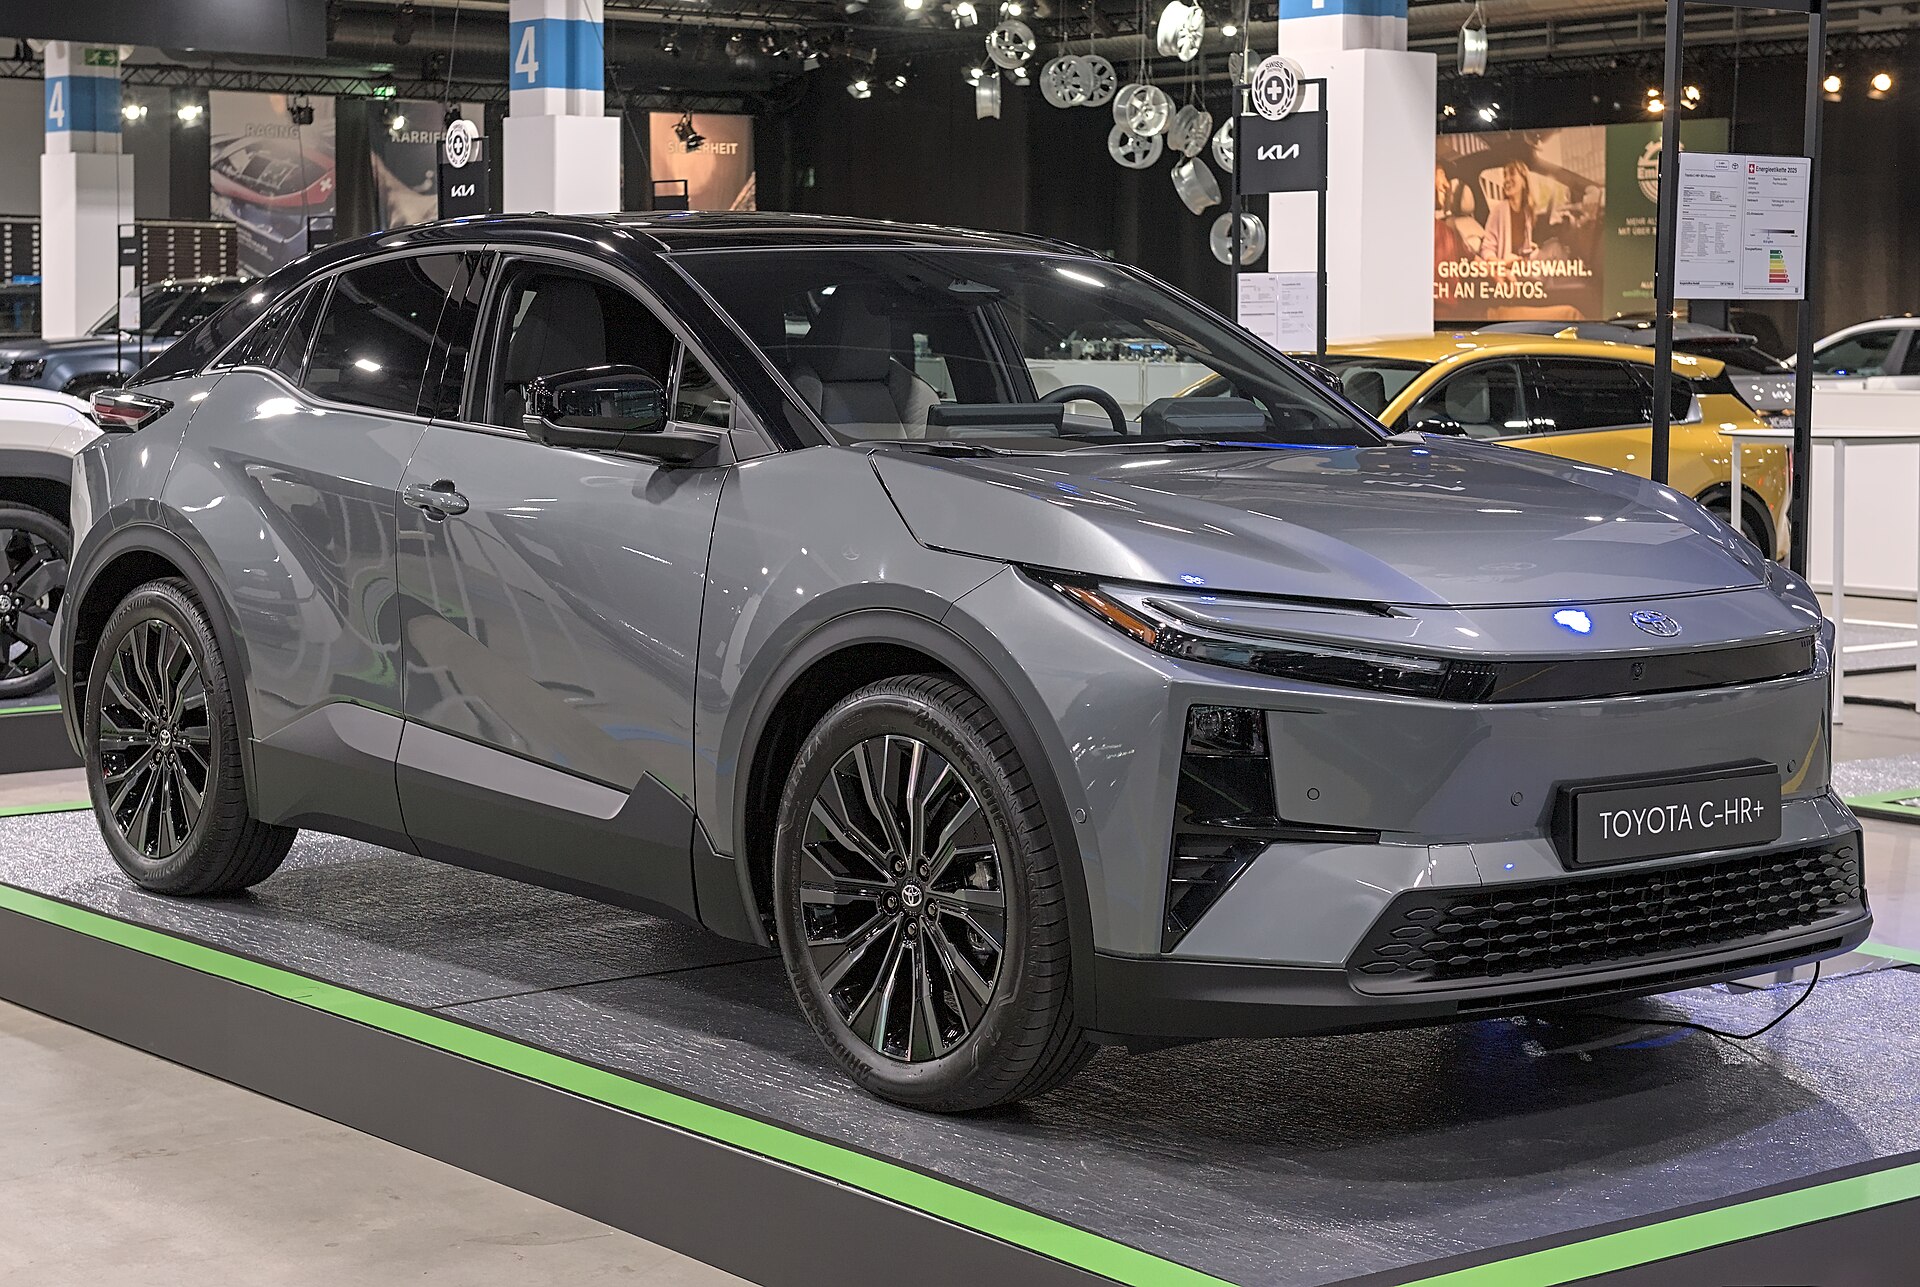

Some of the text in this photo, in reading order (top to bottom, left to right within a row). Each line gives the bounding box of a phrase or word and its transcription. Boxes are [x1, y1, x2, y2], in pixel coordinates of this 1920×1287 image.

[515, 26, 539, 84] 4
[1265, 61, 1284, 70] SWISS
[49, 81, 65, 128] 4
[245, 124, 300, 139] RACING
[668, 142, 739, 155] SICERHEIT
[1257, 144, 1300, 161] KIA
[451, 184, 475, 197] KIA
[1438, 257, 1593, 278] GRÖSSTE AUSWAHL.
[1454, 281, 1475, 299] AN
[1480, 281, 1548, 299] E-AUTOS.
[913, 708, 1009, 830] BRIDGESTONE
[1600, 797, 1765, 839] TOYOTA C-HR+
